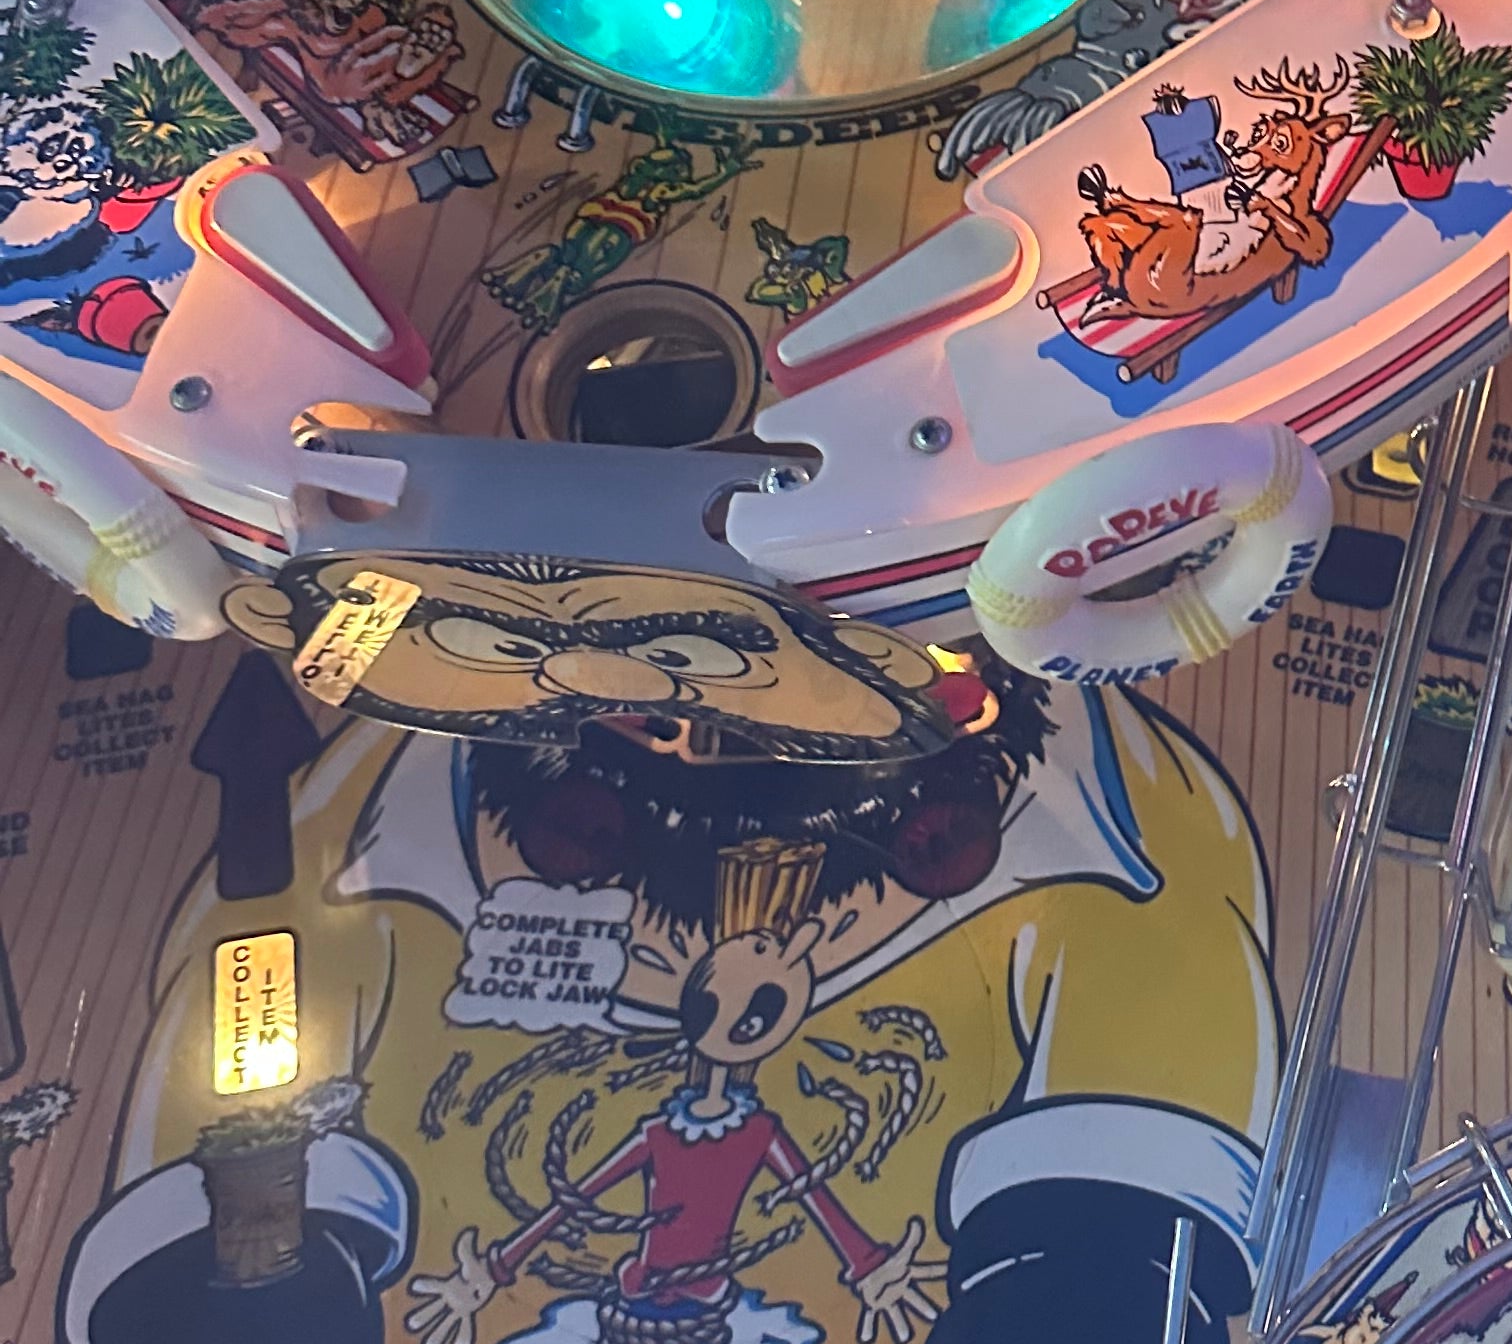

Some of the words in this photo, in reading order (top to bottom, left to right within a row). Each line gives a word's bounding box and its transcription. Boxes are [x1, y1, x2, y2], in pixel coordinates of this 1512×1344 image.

[1249, 540, 1318, 623] EARTH
[1288, 613, 1335, 638] SEA
[1343, 623, 1385, 649] HA
[1301, 636, 1373, 667] LITES
[1039, 656, 1179, 686] PLANET
[1272, 652, 1377, 689] COLLEC
[1292, 677, 1356, 707] ITEM
[477, 912, 626, 940] COMPLETE
[509, 937, 582, 959] JABS
[489, 956, 525, 976] TO
[533, 959, 594, 982] LITE
[463, 977, 539, 1001] LOCK
[545, 983, 609, 1005] JAW
[232, 945, 250, 1084] COLLECT
[259, 967, 280, 1046] ITEM
